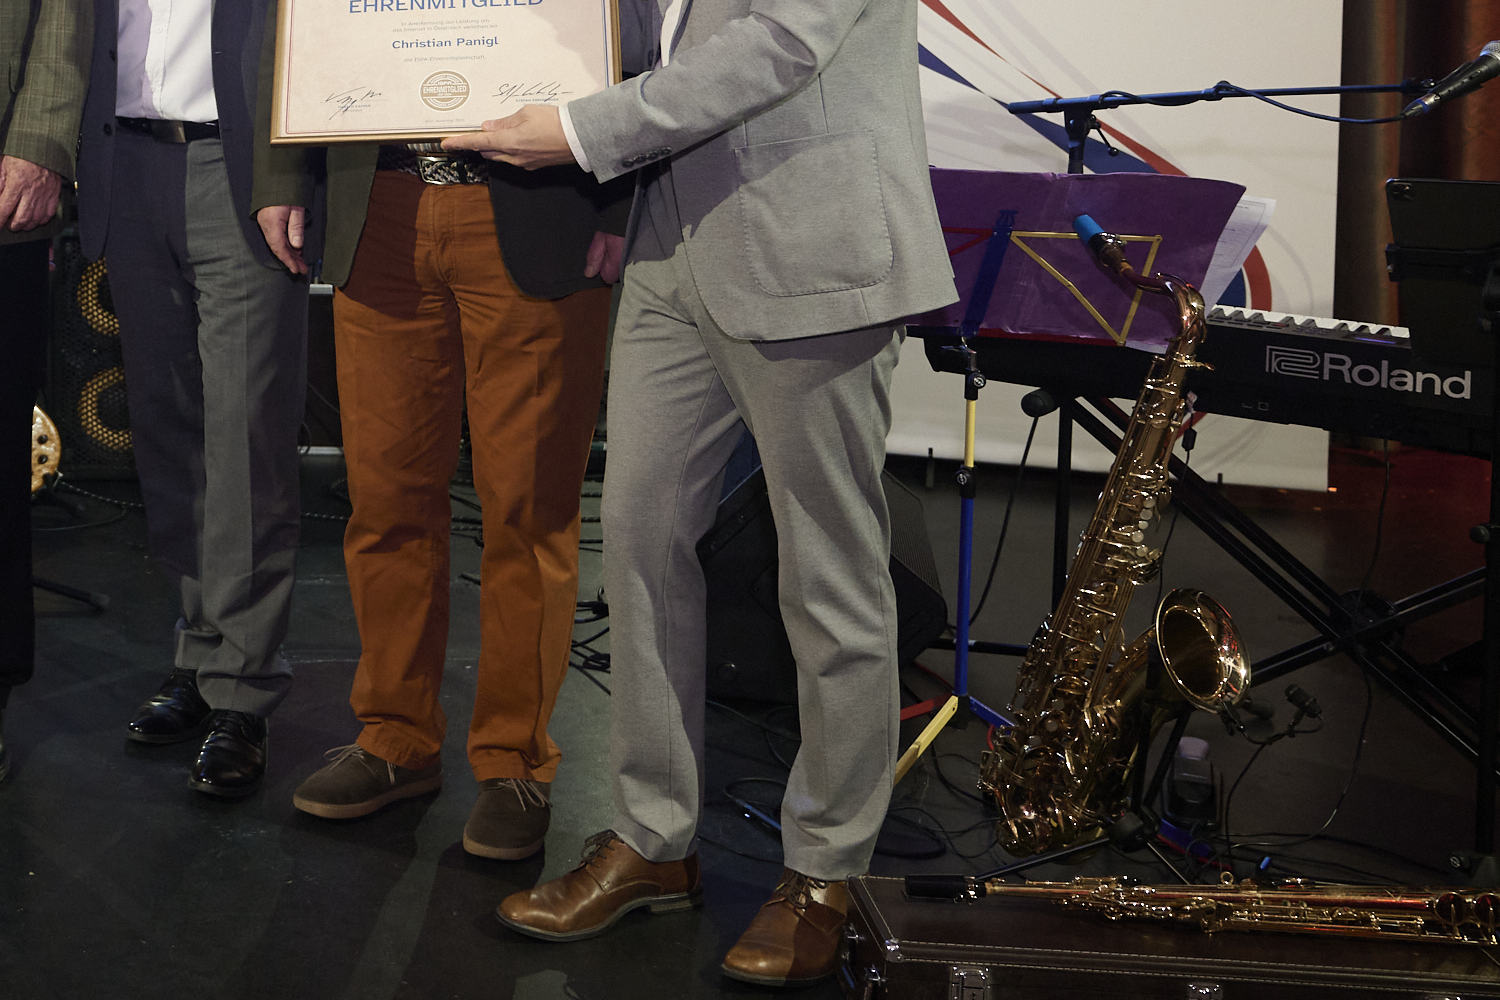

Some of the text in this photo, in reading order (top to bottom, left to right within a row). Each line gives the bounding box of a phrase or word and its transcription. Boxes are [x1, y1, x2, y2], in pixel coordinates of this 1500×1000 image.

[392, 36, 499, 49] Christian Panigl
[422, 85, 467, 94] EHRENMITGLIED
[1323, 353, 1472, 400] Roland
